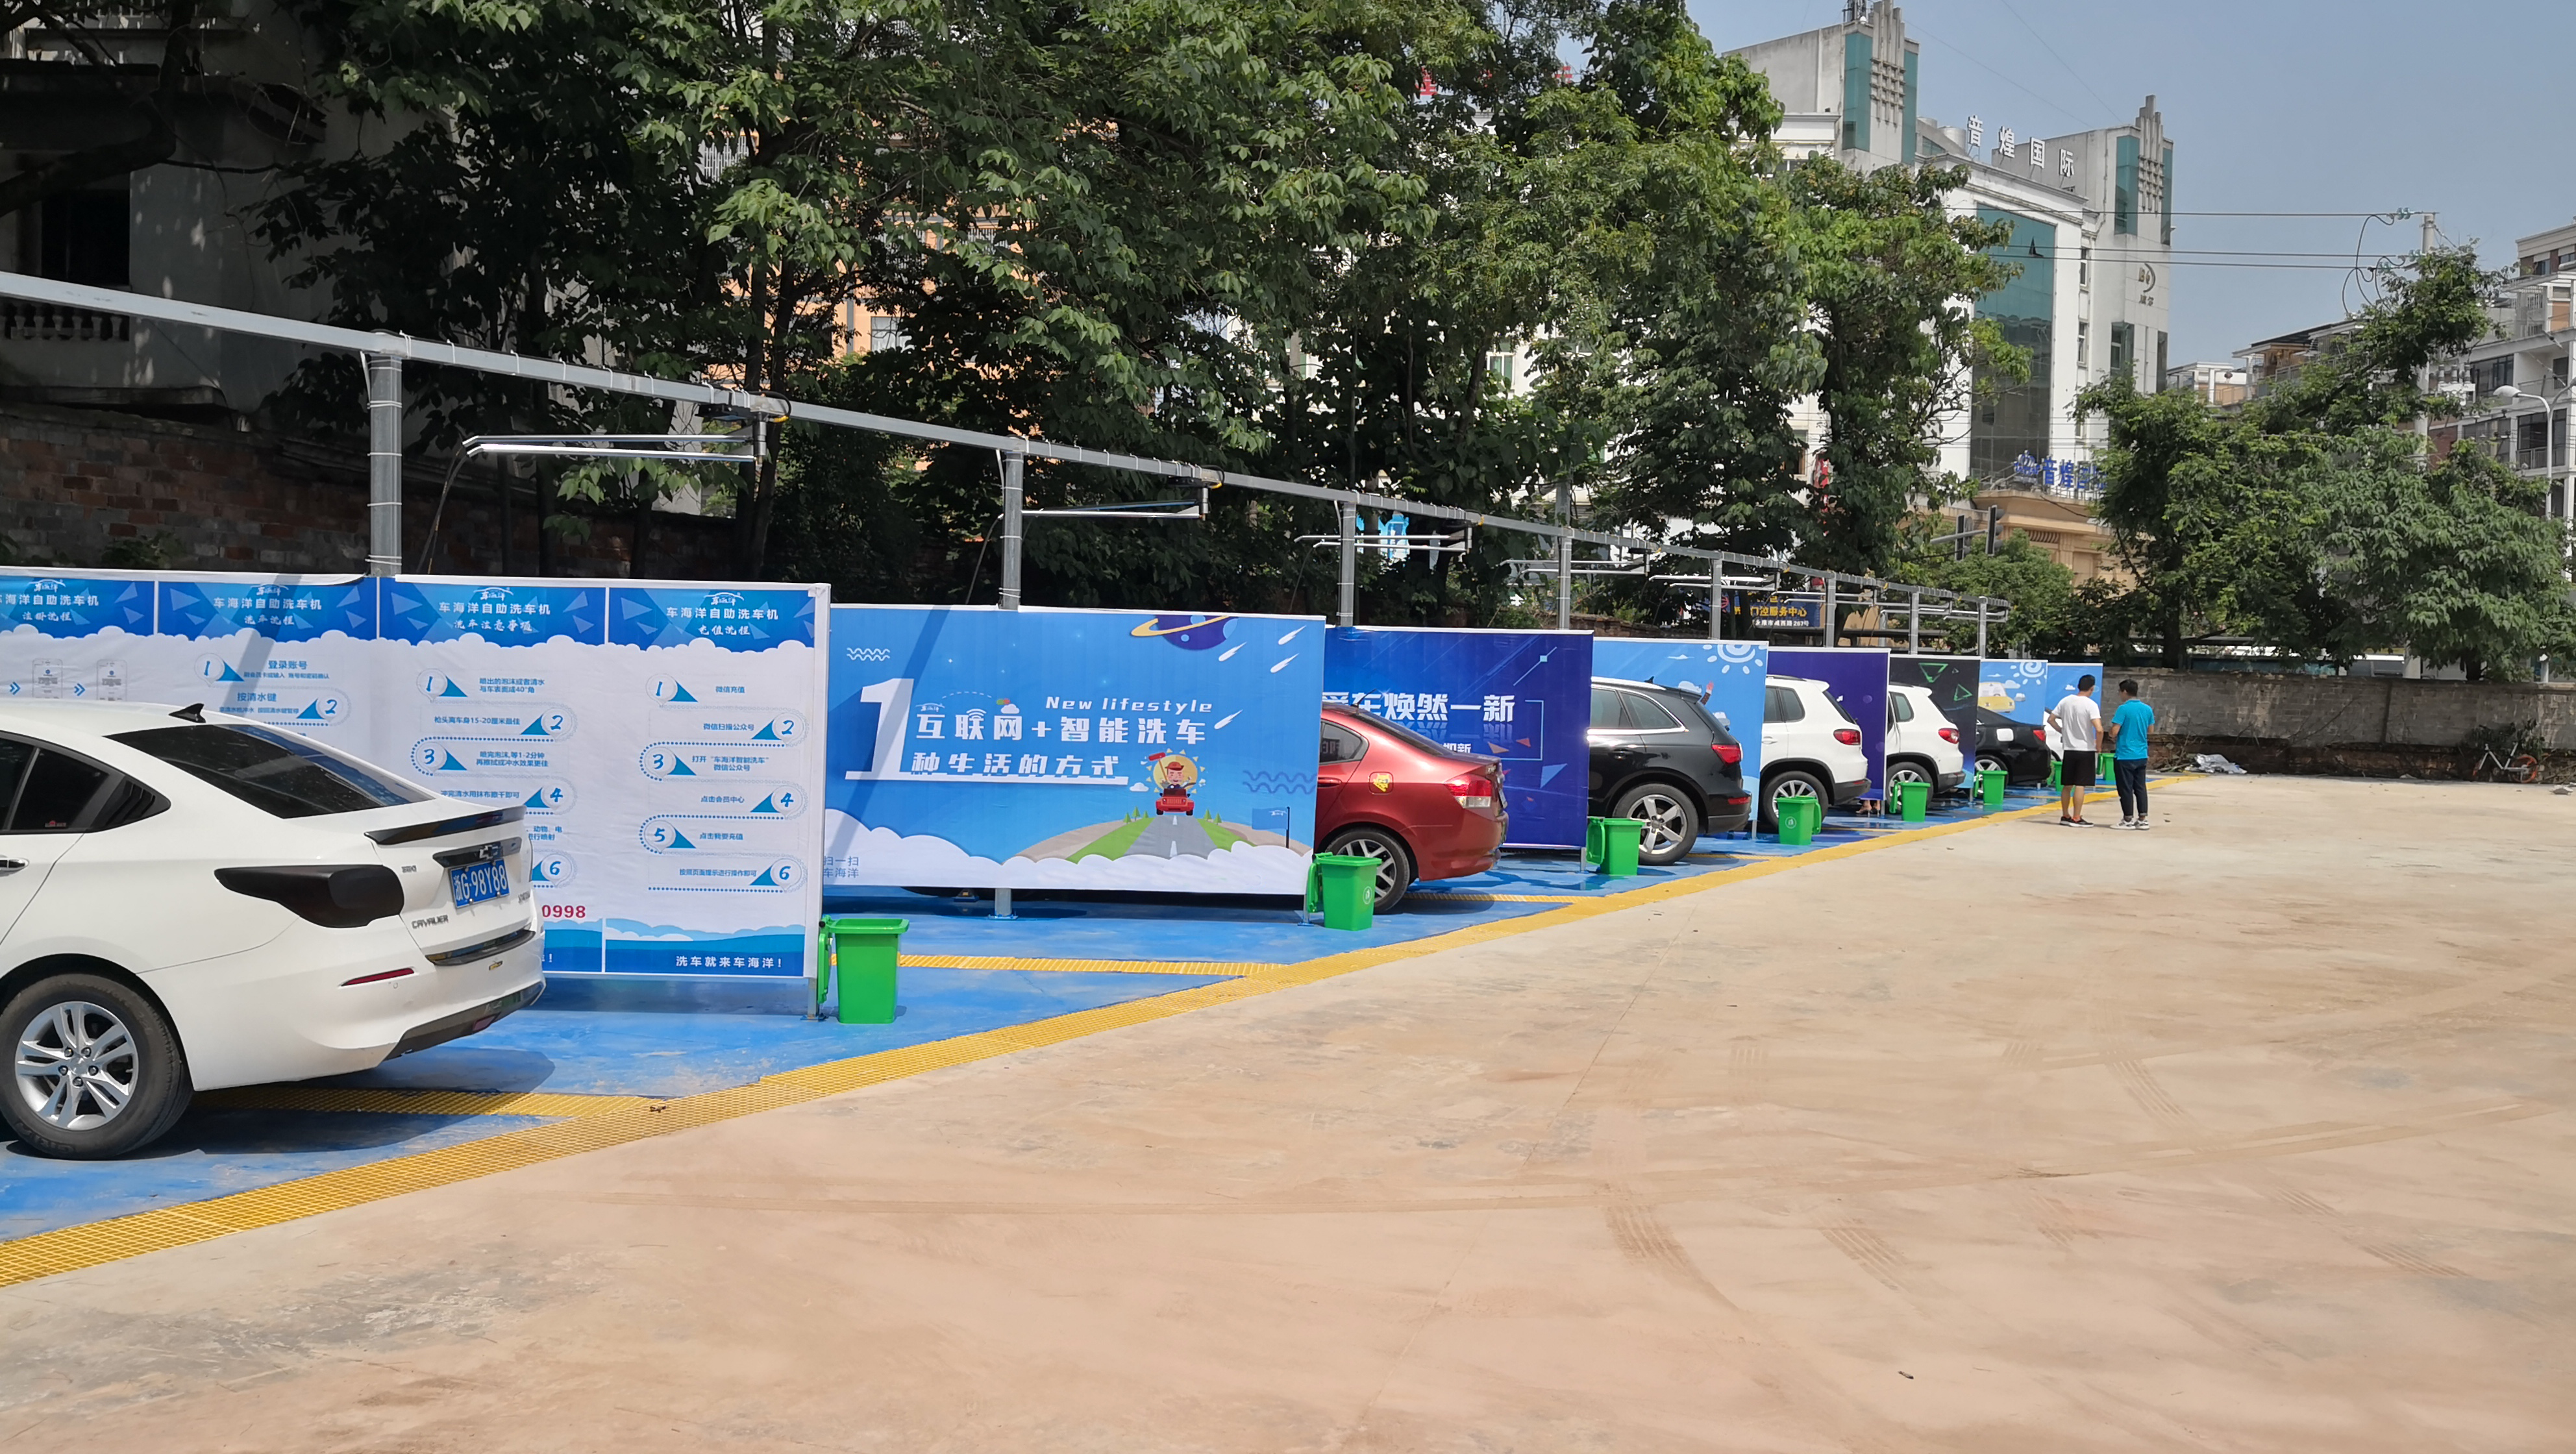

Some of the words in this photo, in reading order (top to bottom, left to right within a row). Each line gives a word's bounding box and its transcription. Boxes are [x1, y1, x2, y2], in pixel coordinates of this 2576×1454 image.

[1968, 115, 2075, 177] 音煌国际
[0, 595, 99, 606] 海洋自助洗车机
[214, 597, 322, 610] 车海洋自助洗车机
[439, 602, 551, 615] 车海洋自助洗车机
[667, 607, 779, 620] 车海洋自助洗车机
[454, 619, 533, 632] 洗车注意事项
[204, 661, 210, 676] 1
[268, 660, 308, 670] 登录账号
[426, 676, 433, 692] 1
[656, 681, 663, 696] 1
[237, 693, 277, 702] 按清水键
[325, 699, 338, 714] 2
[1046, 696, 1092, 710] New
[1103, 698, 1213, 715] lifestyle
[550, 715, 564, 730] 2
[781, 720, 794, 735] 2
[916, 713, 1206, 745] 互联网+智能洗车
[423, 748, 435, 765] 3
[652, 754, 664, 769] 3
[911, 751, 1119, 776] 种生活的方式
[550, 787, 564, 802] 4
[780, 793, 794, 807] 4
[654, 827, 665, 842] 5
[549, 861, 562, 876] 6
[779, 865, 791, 880] 6
[542, 904, 586, 918] 0998
[412, 915, 449, 929] CAVALIER
